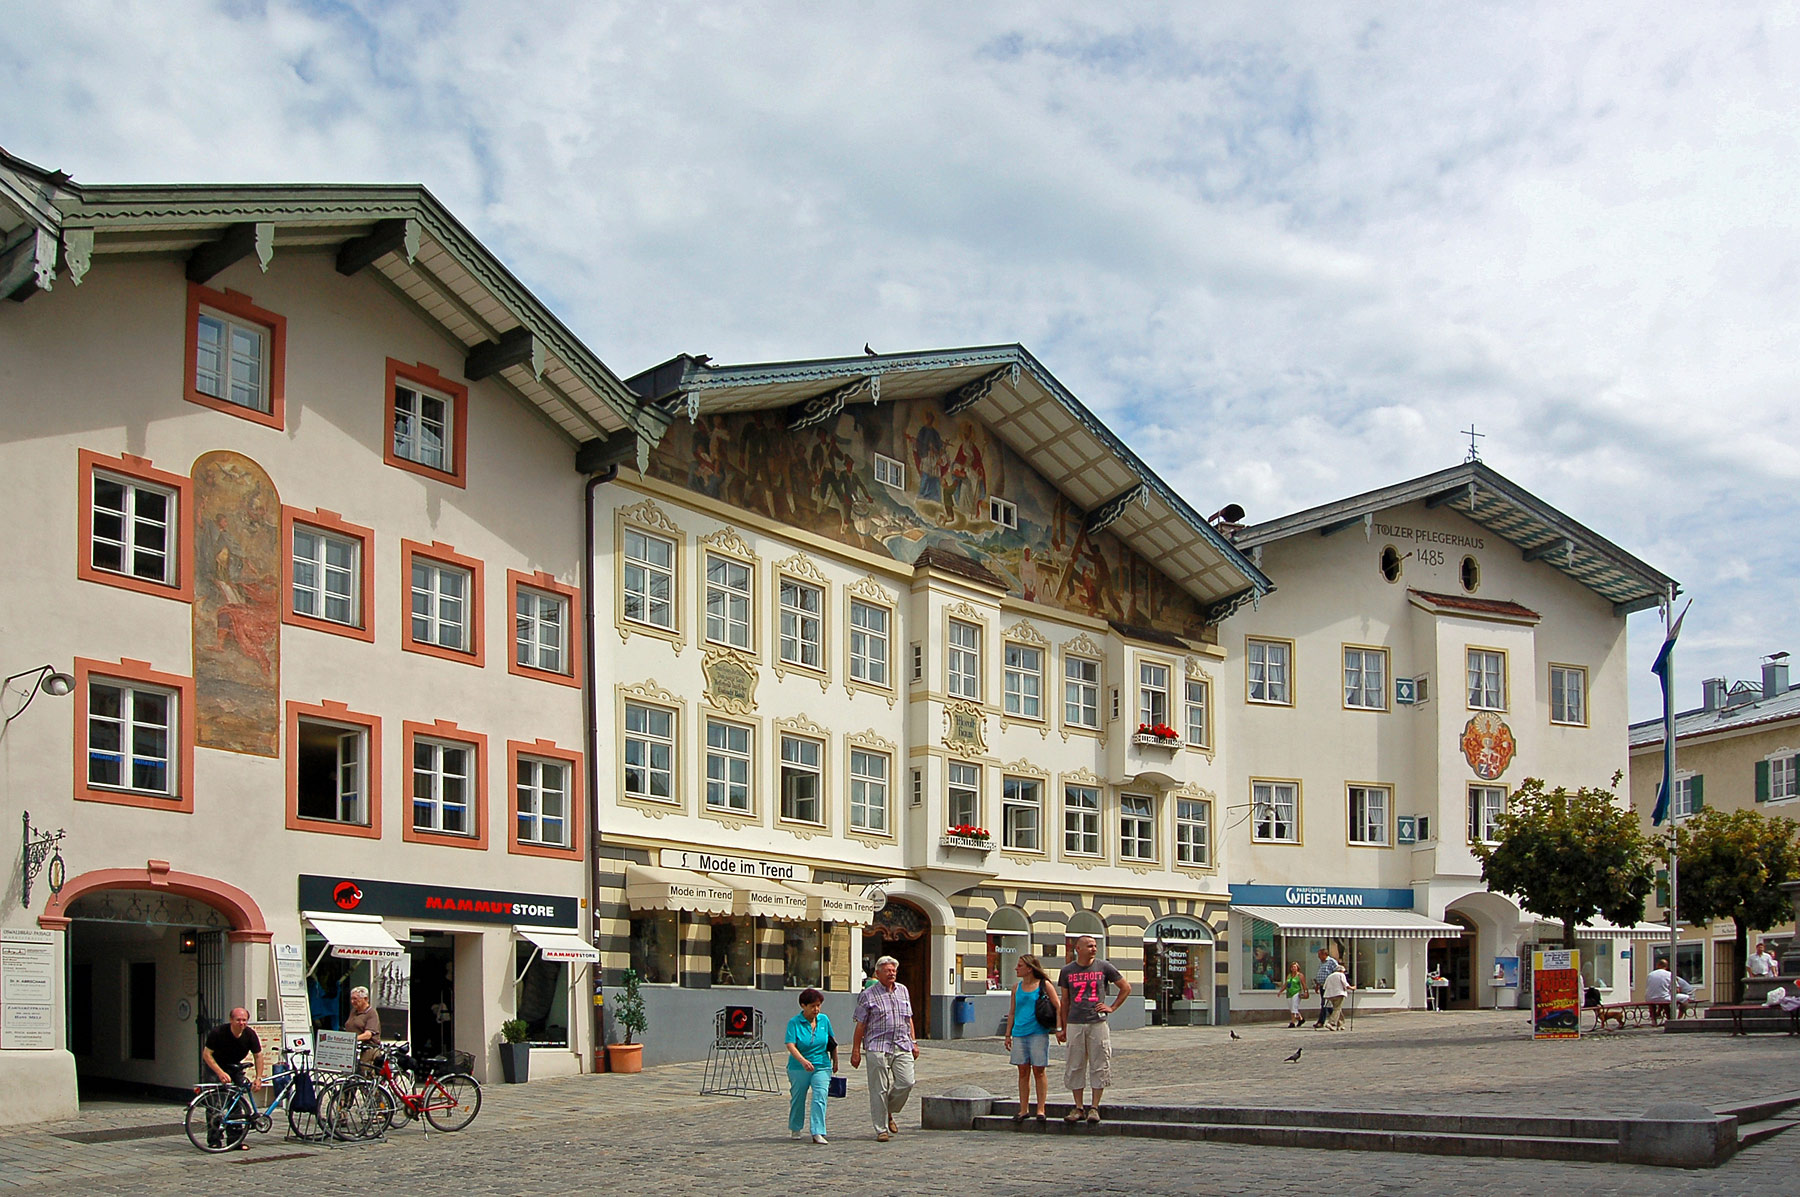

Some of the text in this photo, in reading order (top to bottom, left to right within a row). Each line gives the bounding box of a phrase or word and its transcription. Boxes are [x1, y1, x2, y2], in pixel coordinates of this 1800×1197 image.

[1415, 529, 1484, 549] PFLEGERHAUS
[1416, 549, 1445, 566] 1485
[699, 855, 736, 872] Mode
[740, 860, 755, 875] im
[759, 862, 793, 878] Trend
[670, 885, 733, 900] Mode im Trend
[751, 893, 807, 907] Mode im Trend
[1285, 887, 1363, 906] WIEDEMANN
[823, 899, 843, 910] Mode
[843, 901, 853, 911] im
[854, 902, 873, 912] Trend
[1068, 971, 1104, 982] DETROIT
[1073, 981, 1099, 1002] 71
